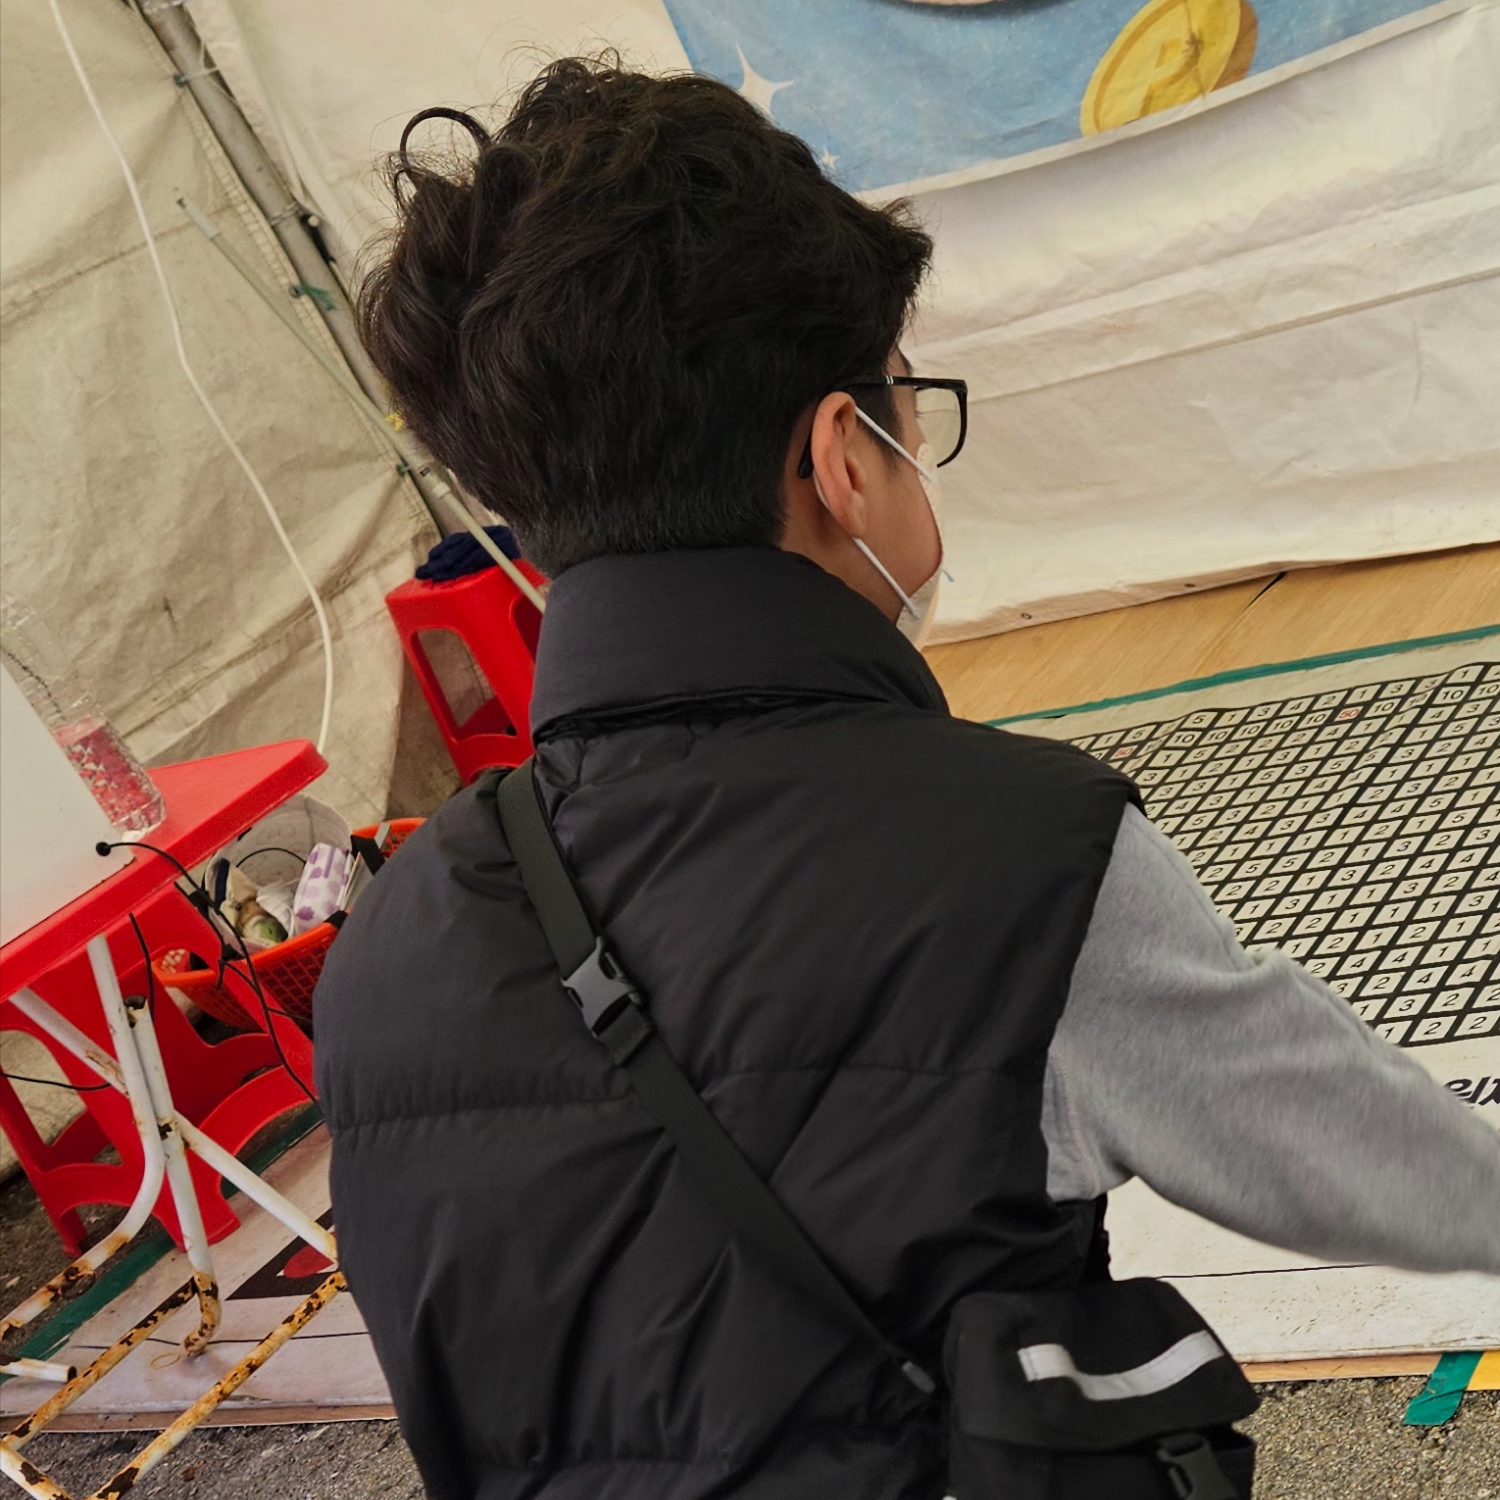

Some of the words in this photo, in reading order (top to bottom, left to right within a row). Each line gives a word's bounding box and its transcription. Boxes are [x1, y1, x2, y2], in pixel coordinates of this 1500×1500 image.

[1226, 885, 1242, 896] 2
[1264, 880, 1280, 892] 2
[1307, 876, 1316, 886] 1
[1341, 870, 1356, 881] 3
[1379, 864, 1395, 875] 2
[1419, 858, 1435, 869] 4
[1460, 853, 1475, 863] 4
[1351, 957, 1366, 968] 4
[1392, 952, 1408, 963] 4
[1439, 946, 1449, 957] 1
[1482, 940, 1491, 951] 1
[1385, 1026, 1395, 1039] 1
[1424, 1022, 1442, 1035] 2
[1469, 1016, 1487, 1030] 2
